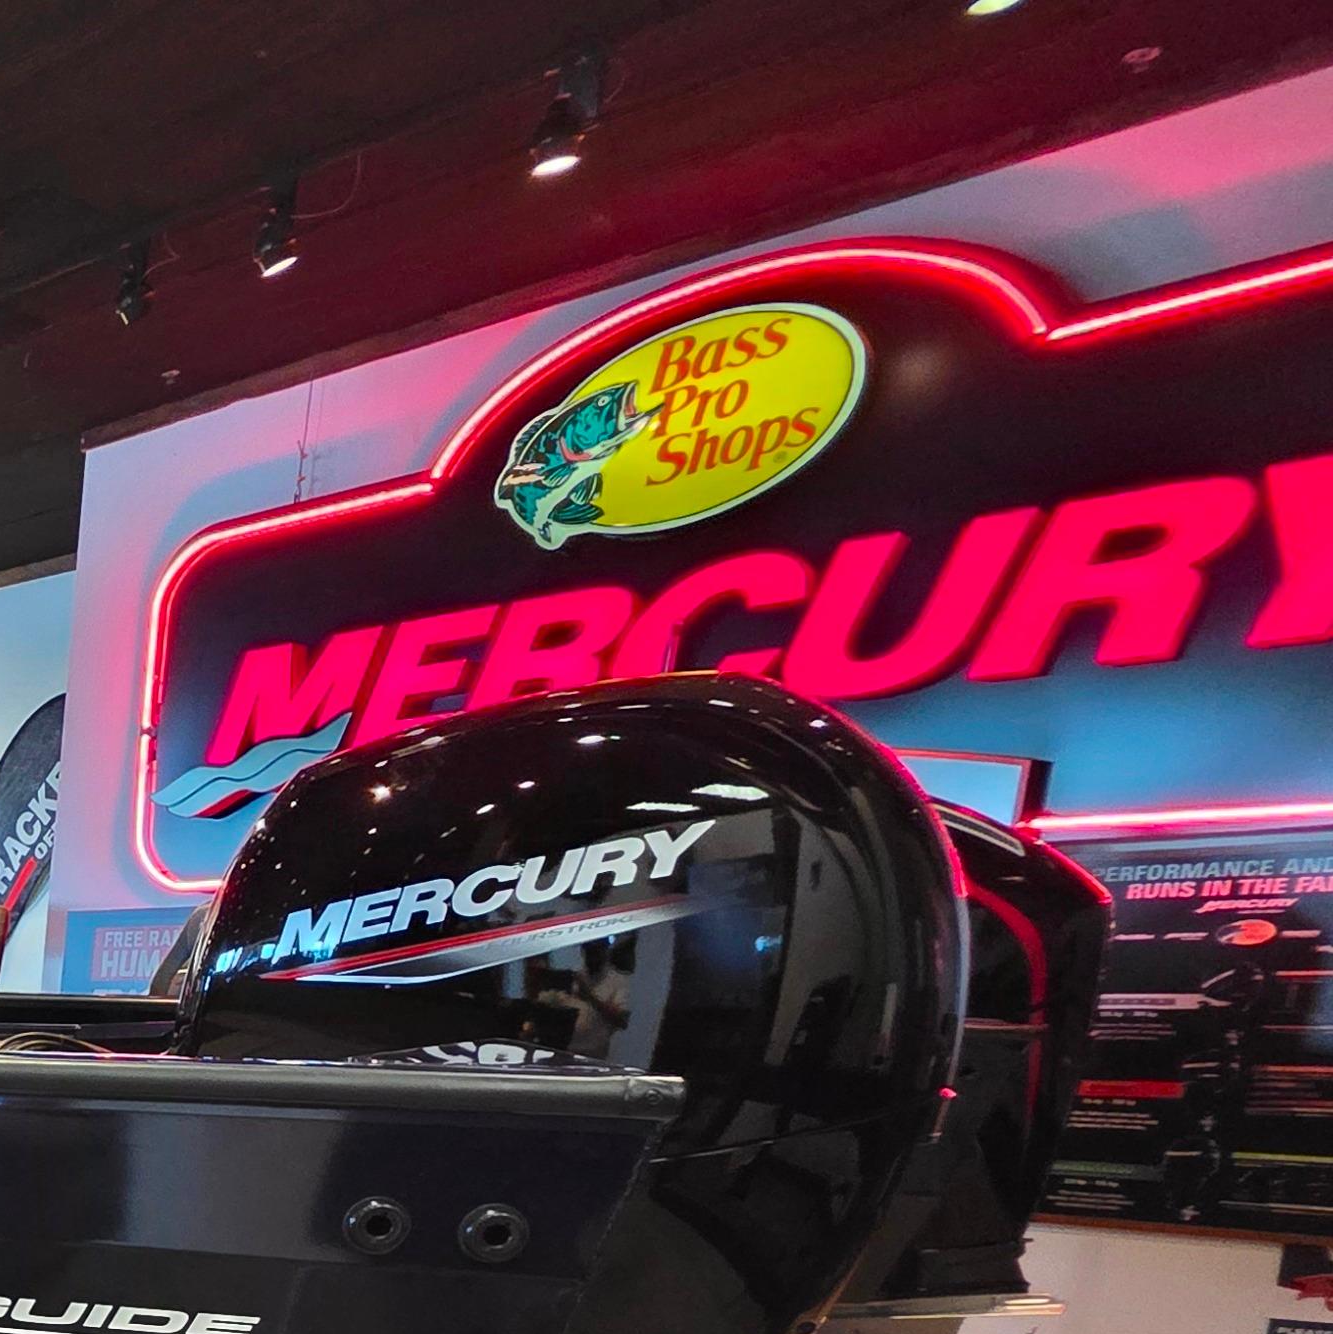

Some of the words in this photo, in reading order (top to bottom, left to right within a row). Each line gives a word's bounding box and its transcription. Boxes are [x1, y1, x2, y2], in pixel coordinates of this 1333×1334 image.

[649, 318, 793, 395] Bass
[652, 378, 750, 439] Pro
[645, 406, 821, 487] Shops
[34, 821, 57, 860] OF
[271, 819, 717, 965] MERCURY
[1092, 859, 1275, 882] PERFORMANCE
[1125, 881, 1197, 899] RUNS
[1200, 880, 1232, 897] IN
[1238, 877, 1289, 894] THE
[104, 930, 143, 947] FREE
